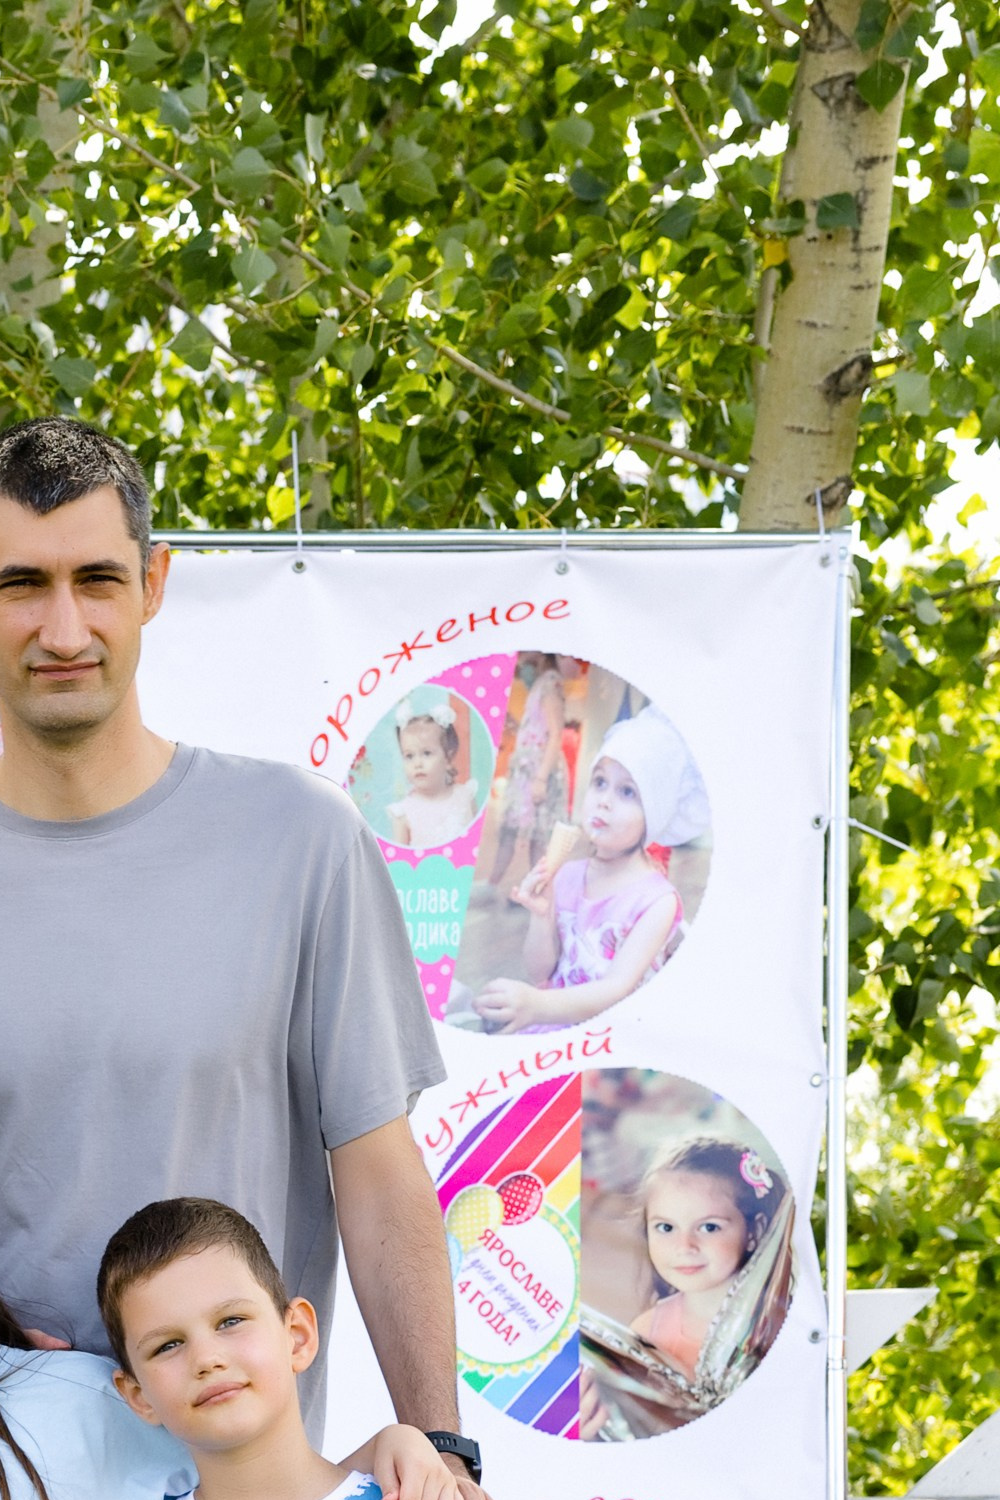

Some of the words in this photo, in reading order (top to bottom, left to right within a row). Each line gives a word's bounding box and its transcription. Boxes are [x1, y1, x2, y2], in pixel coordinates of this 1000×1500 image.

[309, 599, 570, 768] ороженое
[425, 1027, 613, 1155] ужный
[457, 1280, 471, 1294] 4
[468, 1291, 520, 1346] ГОДА!
[478, 1228, 563, 1319] ЯРОСЛАВЕ
